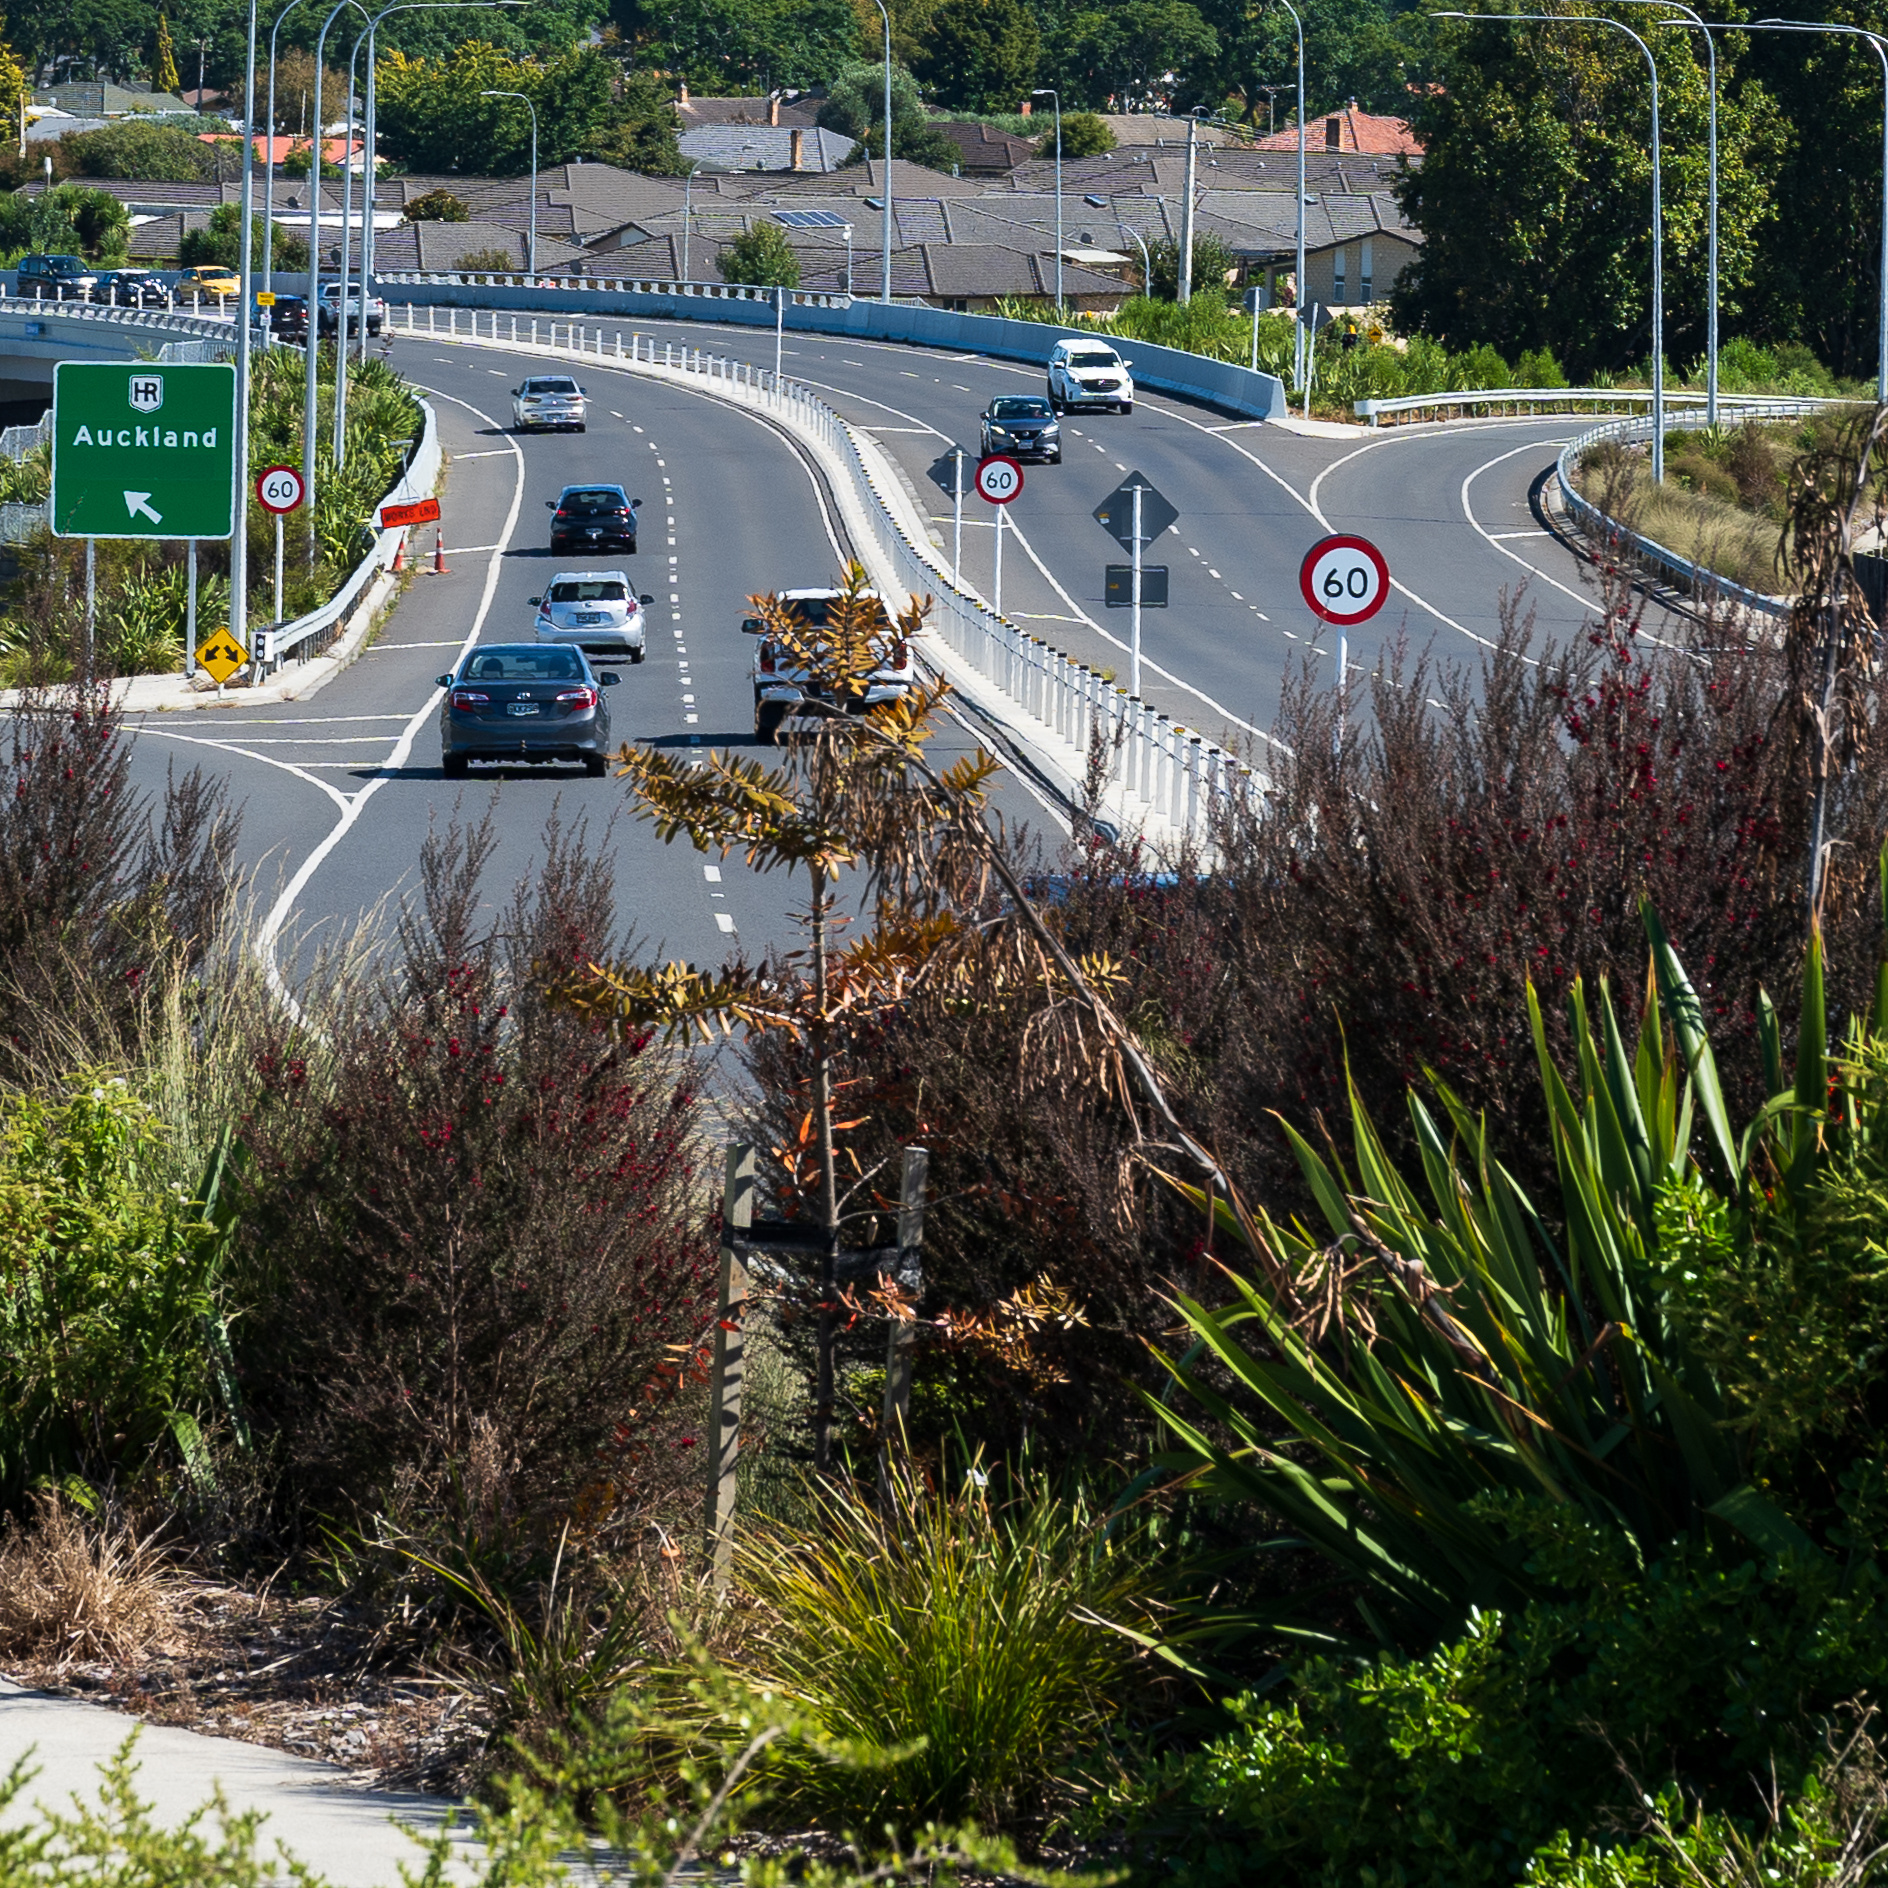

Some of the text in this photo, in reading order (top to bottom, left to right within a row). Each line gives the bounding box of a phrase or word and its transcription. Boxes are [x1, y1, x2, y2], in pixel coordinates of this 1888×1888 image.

[133, 381, 158, 402] HR
[73, 424, 217, 448] Auckland
[267, 480, 294, 498] 60
[986, 471, 1012, 489] 60
[1323, 566, 1368, 599] 60
